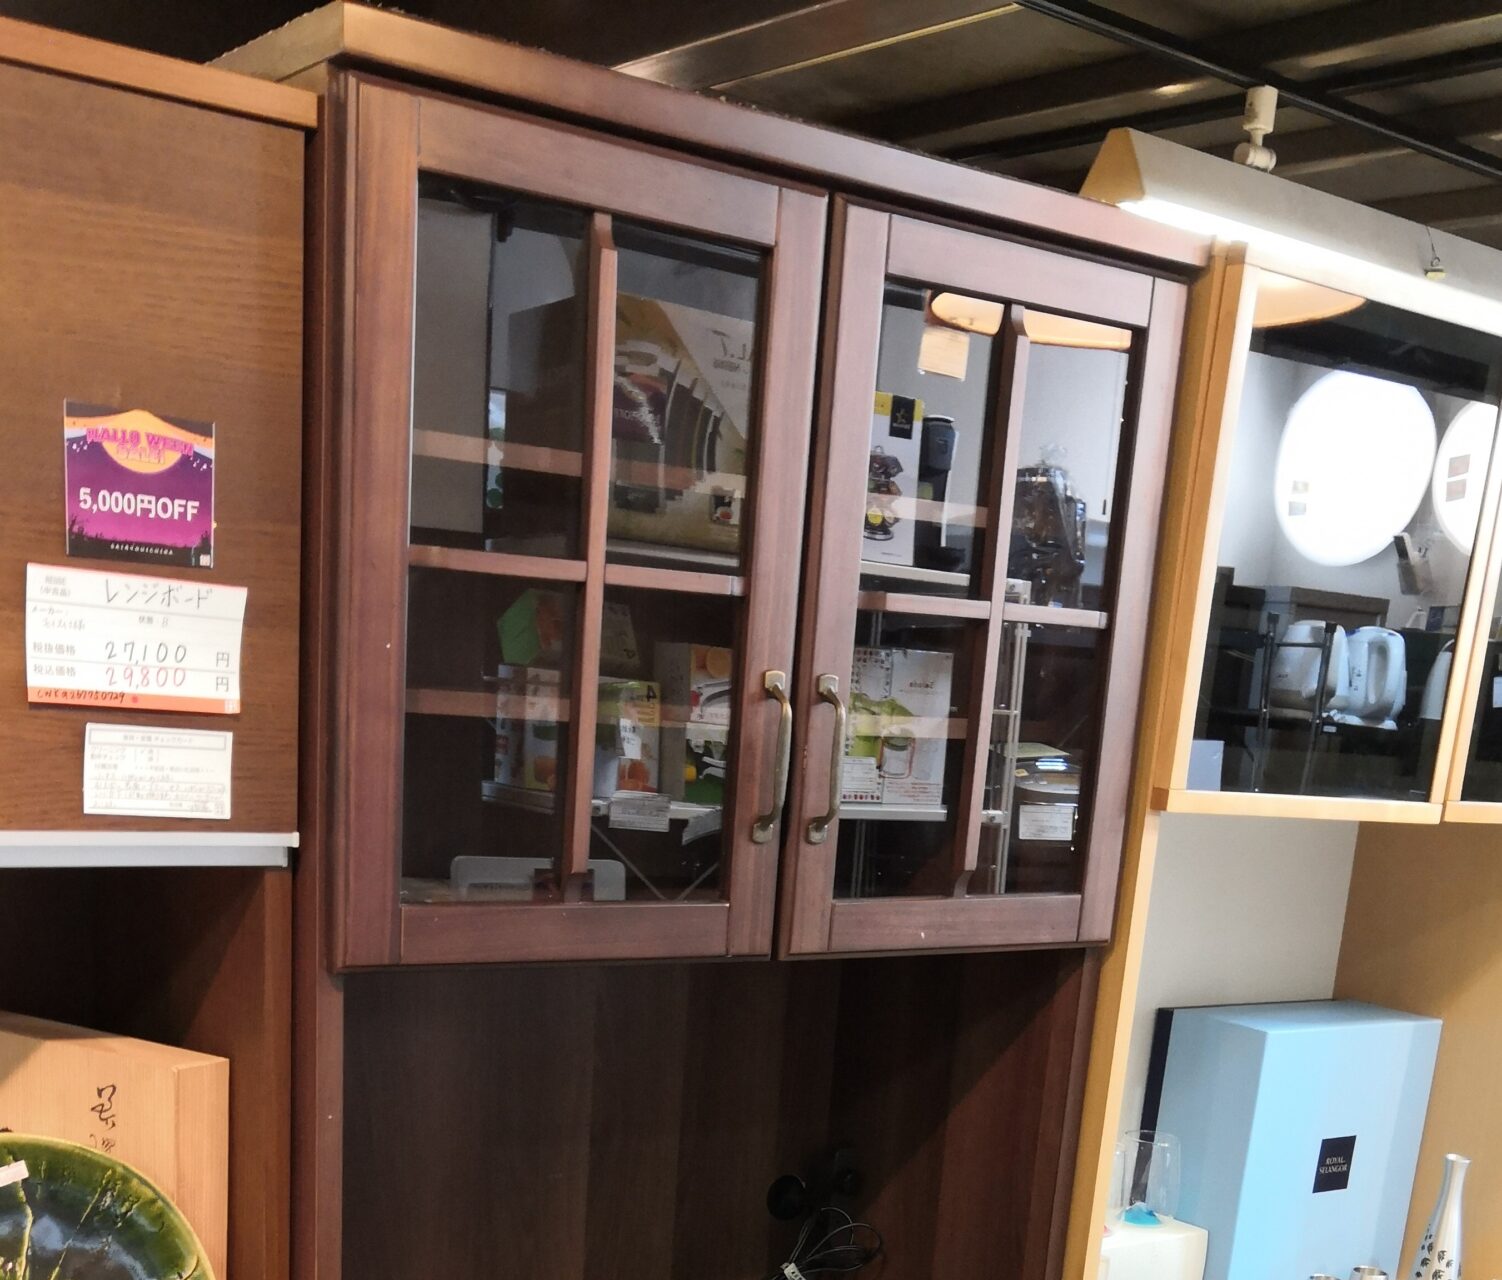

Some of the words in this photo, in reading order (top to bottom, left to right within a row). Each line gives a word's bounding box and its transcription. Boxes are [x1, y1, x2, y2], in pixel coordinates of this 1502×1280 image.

[79, 487, 200, 522] 5,000円OFF
[105, 578, 213, 609] レンジボード
[105, 640, 187, 665] 27,100
[216, 651, 230, 668] 円
[105, 666, 187, 690] 29,800
[216, 676, 230, 692] 円
